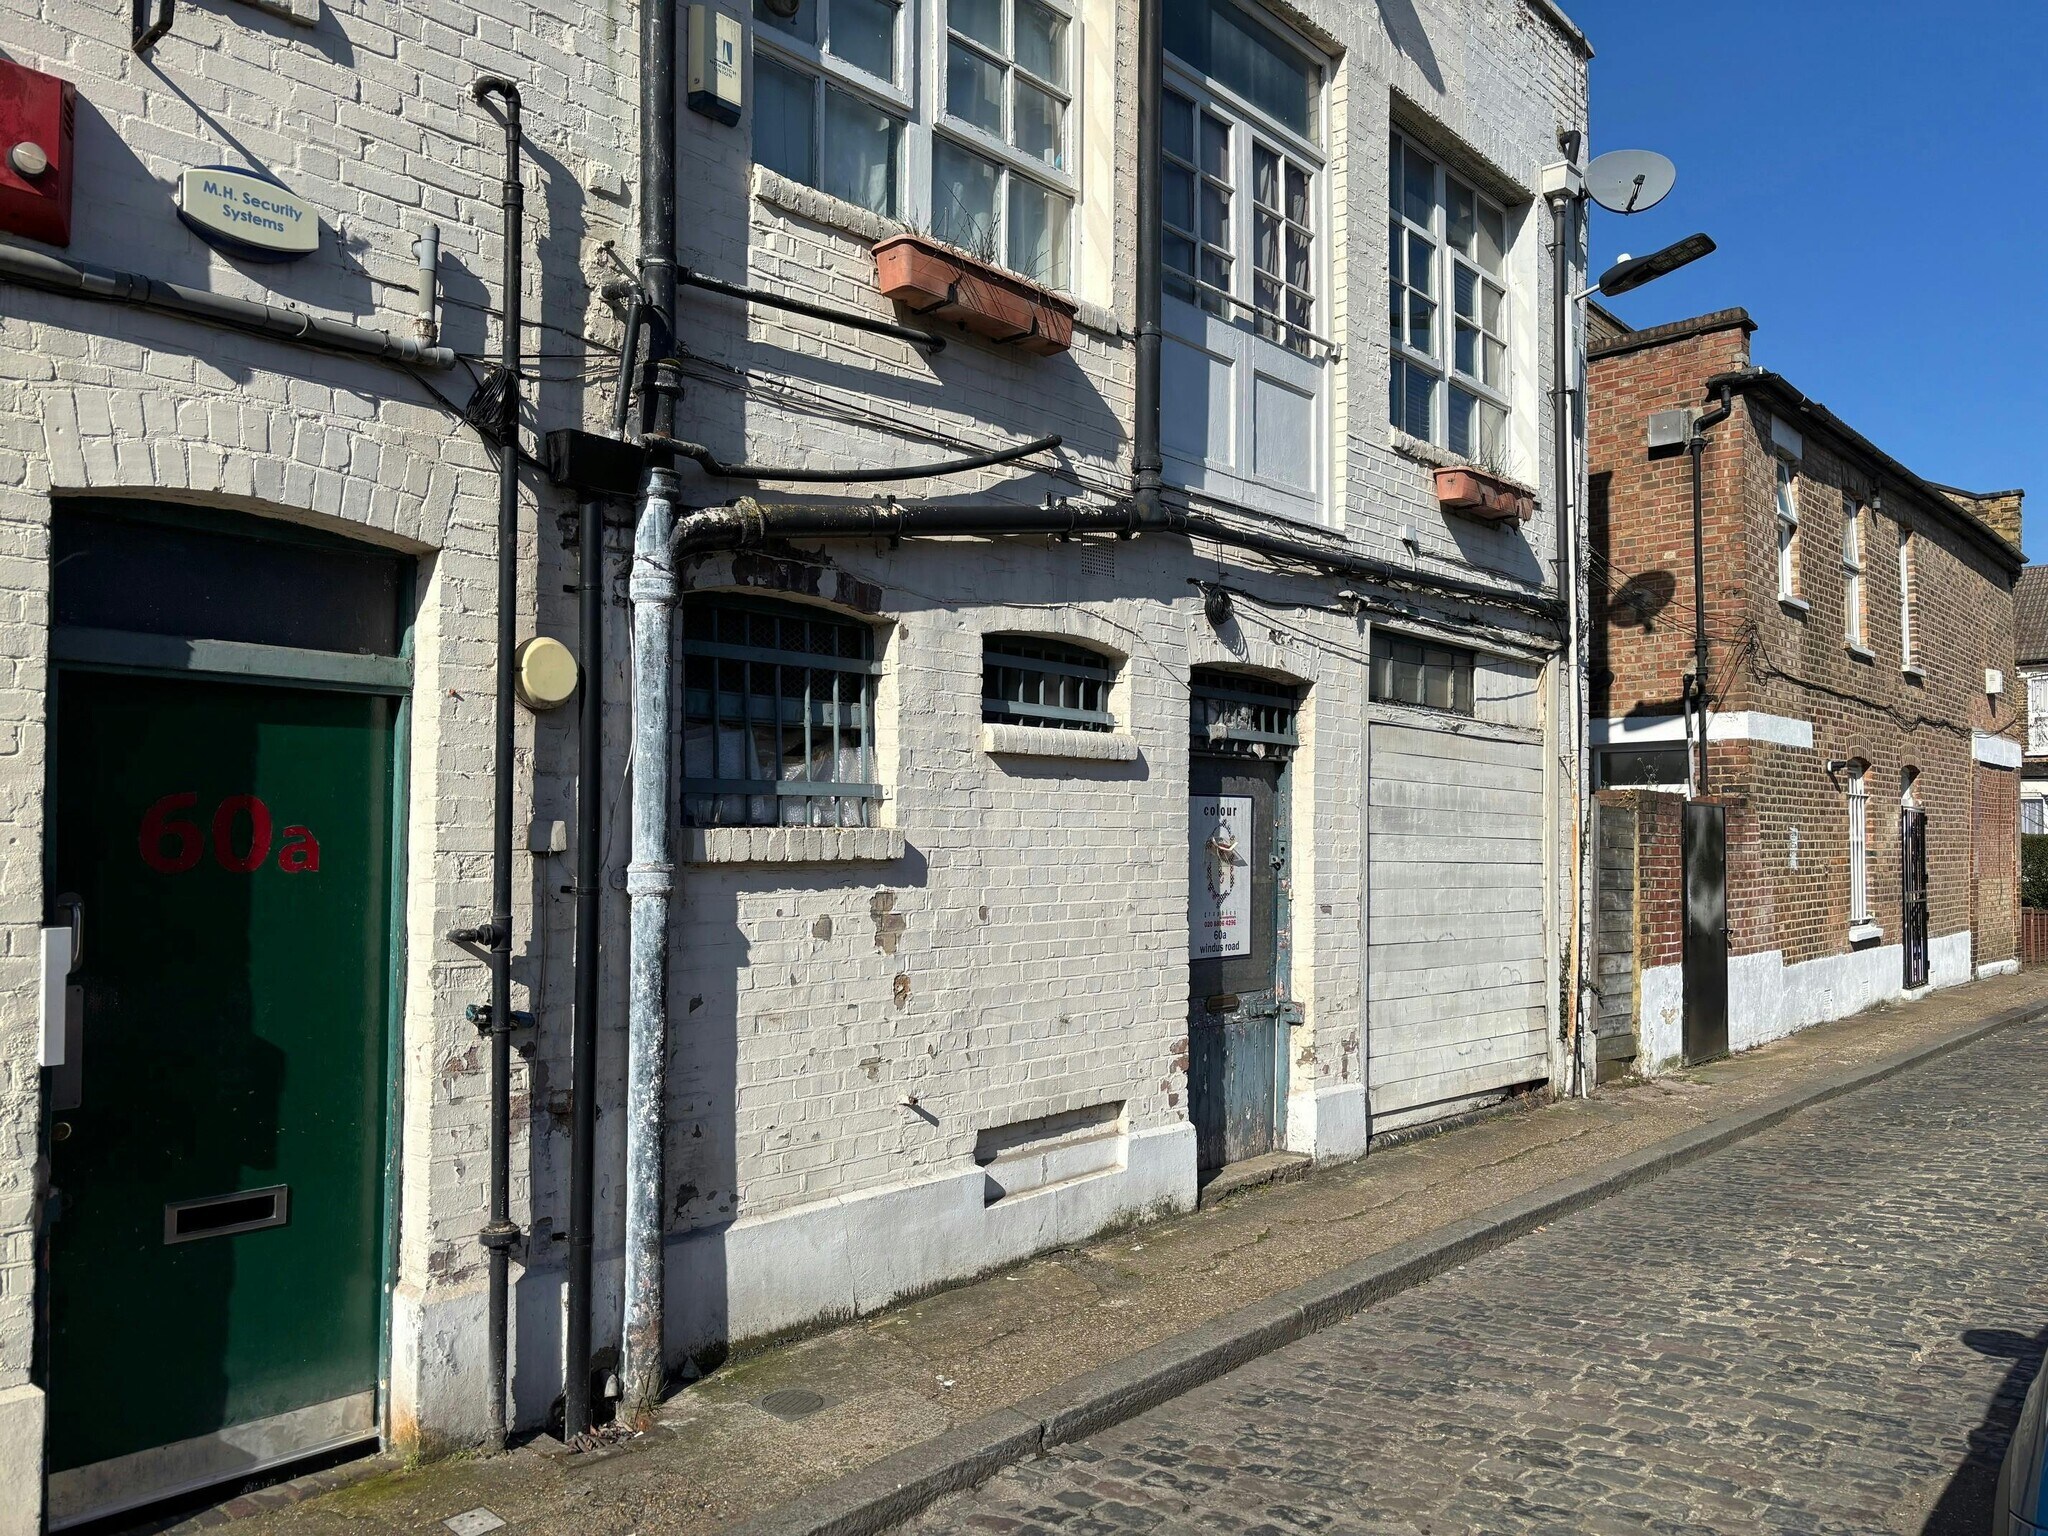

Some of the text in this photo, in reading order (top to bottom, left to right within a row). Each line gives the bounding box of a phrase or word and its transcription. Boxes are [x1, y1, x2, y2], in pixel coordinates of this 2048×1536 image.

[203, 180, 302, 222] M.H. Security
[222, 204, 284, 232] Systems
[1203, 804, 1237, 816] colour
[138, 792, 320, 874] 60a
[1213, 930, 1227, 940] 60a
[1200, 941, 1240, 954] windus road
